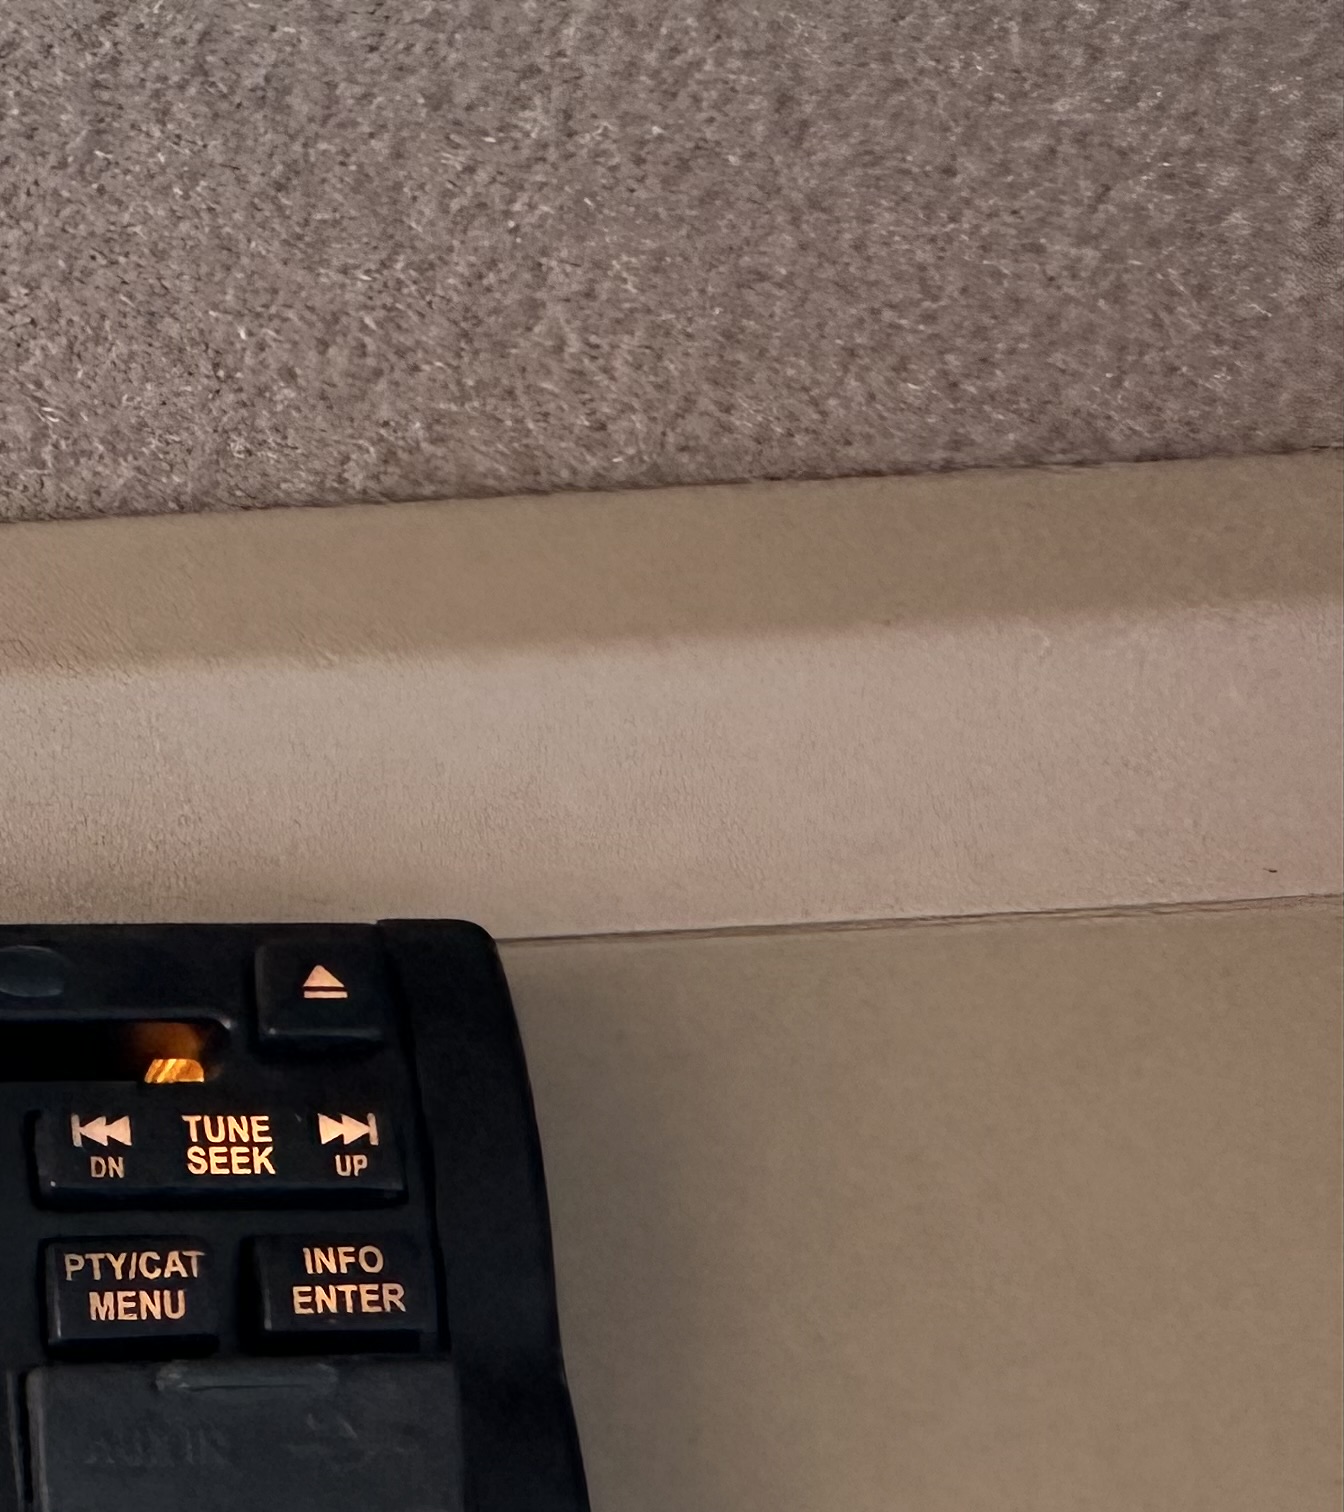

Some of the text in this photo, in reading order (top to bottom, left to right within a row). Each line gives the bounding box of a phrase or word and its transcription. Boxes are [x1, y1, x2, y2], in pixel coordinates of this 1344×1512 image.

[181, 1114, 274, 1145] TUNE
[89, 1156, 126, 1179] DN
[185, 1145, 277, 1177] SEEK
[334, 1153, 369, 1177] UP
[63, 1249, 206, 1282] PTY/CAT
[303, 1244, 385, 1276] INFO
[88, 1289, 188, 1322] MENU
[291, 1281, 407, 1316] ENTER
